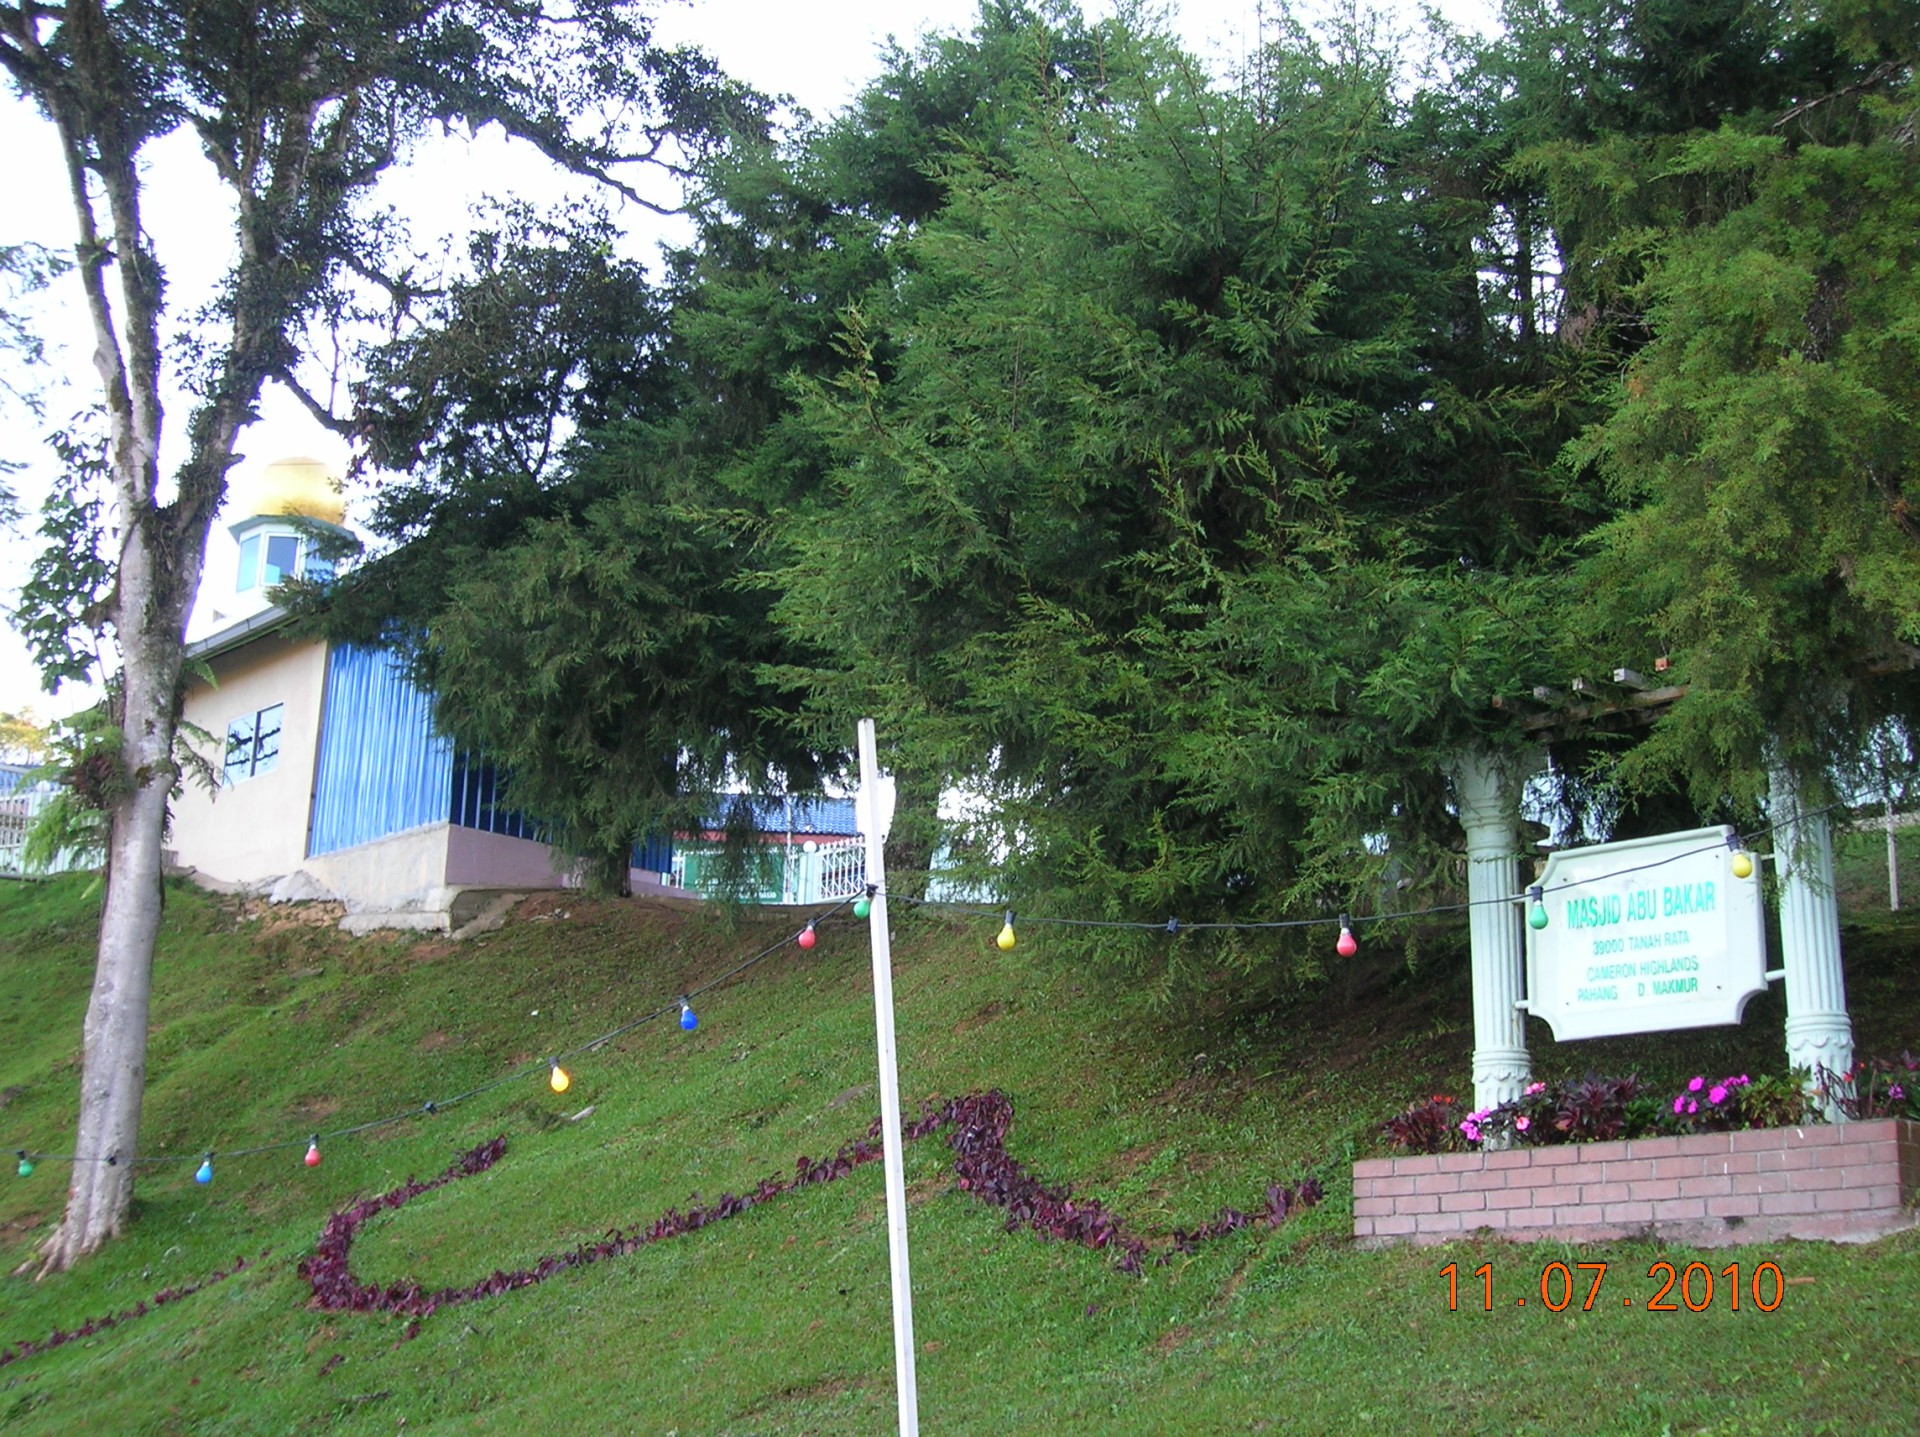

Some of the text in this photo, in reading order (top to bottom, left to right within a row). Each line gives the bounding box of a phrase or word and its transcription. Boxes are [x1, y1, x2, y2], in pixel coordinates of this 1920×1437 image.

[1567, 881, 1716, 929] MASJID ABU BAKAR
[1593, 930, 1690, 956] 39000 TANAH RATA
[1587, 955, 1699, 982] CAMERON HIGHLANDS
[1578, 986, 1618, 1002] PAHANG
[1652, 977, 1699, 996] MAKMUR
